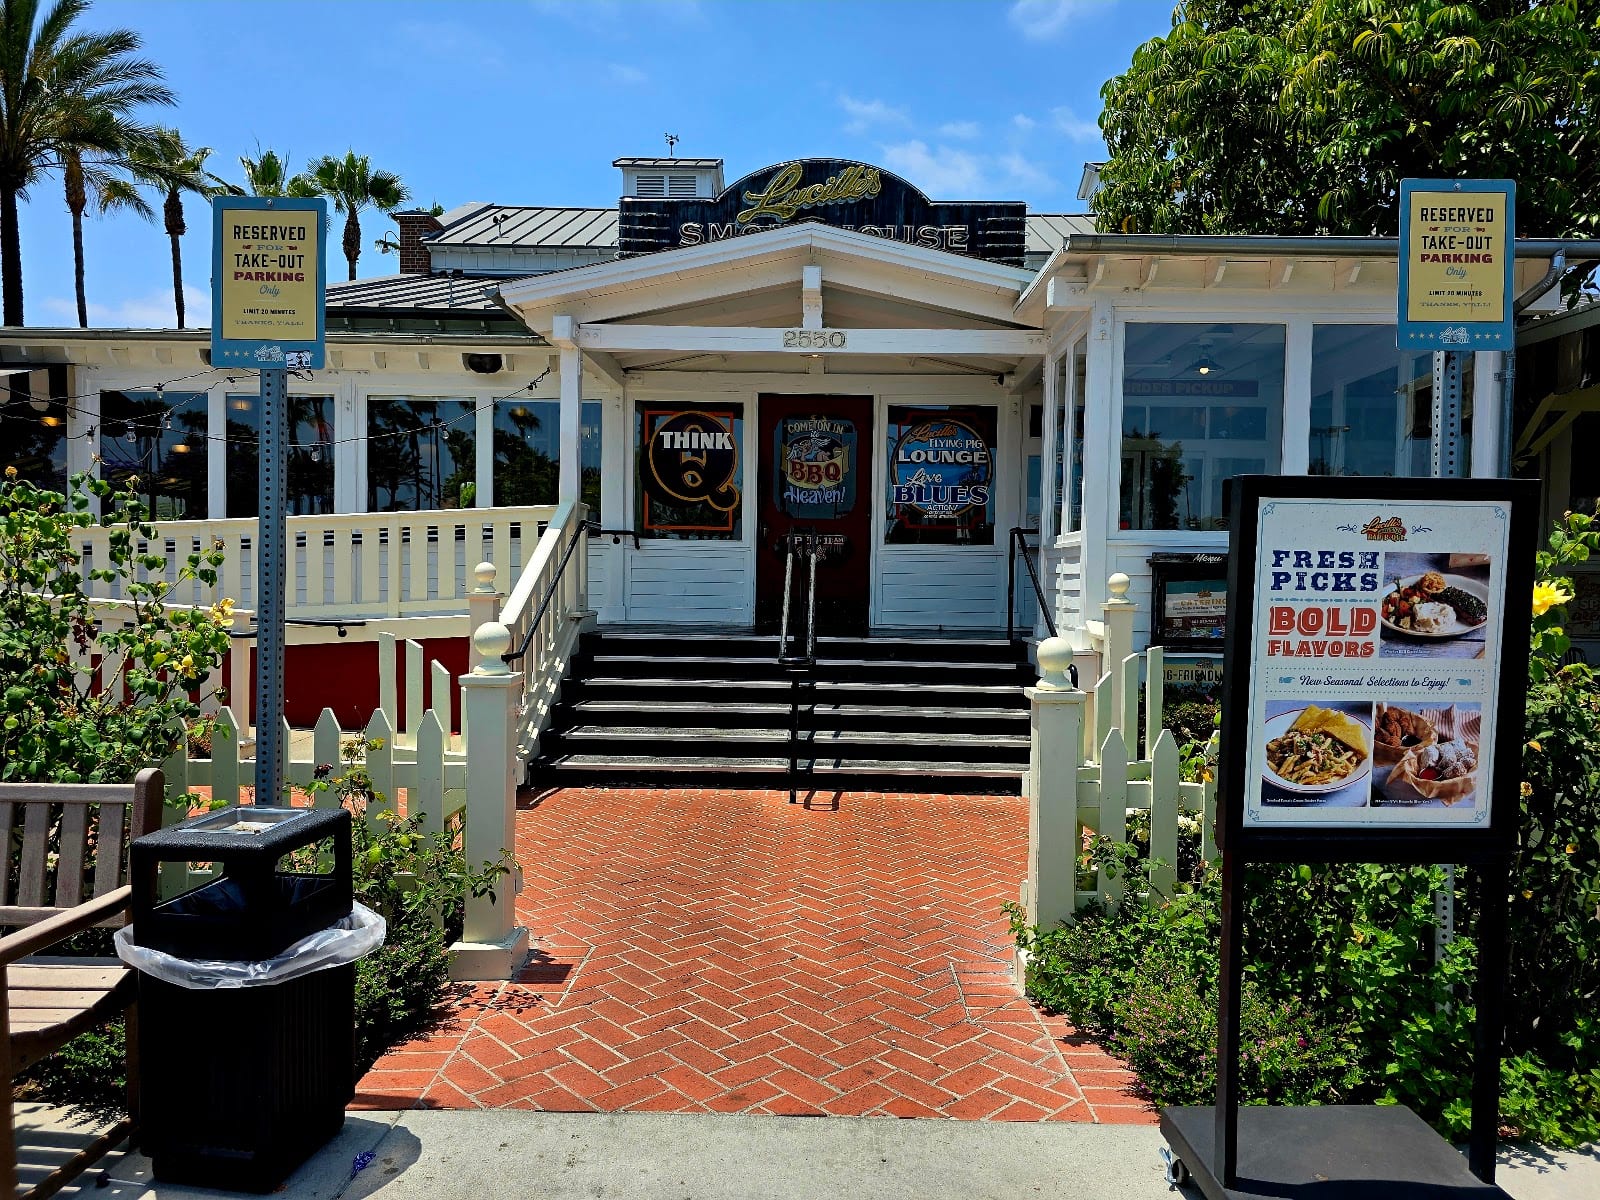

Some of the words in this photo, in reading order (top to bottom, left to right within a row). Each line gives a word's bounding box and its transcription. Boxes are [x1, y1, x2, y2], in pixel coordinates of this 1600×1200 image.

[736, 163, 881, 223] Lucille's
[1420, 207, 1494, 222] RESERVED
[233, 225, 306, 241] RESERVED
[1422, 235, 1493, 250] TAKE-OUT
[234, 253, 305, 268] TAKE-OUT
[1420, 253, 1493, 264] PARKING
[233, 271, 305, 282] PARKING
[1446, 266, 1468, 279] Only
[259, 284, 281, 297] Only
[784, 330, 846, 348] 2550
[1175, 382, 1234, 394] PICKUP
[659, 431, 734, 450] THINK
[907, 424, 958, 443] Lucille's
[929, 438, 963, 448] FLYING
[965, 439, 983, 449] PIG
[897, 449, 988, 463] LOUNGE
[904, 467, 943, 488] Live
[783, 484, 846, 504] Heaven!
[892, 484, 990, 506] BLUES
[1271, 550, 1380, 570] FRESH
[1270, 571, 1379, 592] PICKS
[1268, 606, 1377, 637] BOLD
[1267, 639, 1375, 658] FLAVORS
[1300, 675, 1323, 686] New
[1323, 675, 1364, 687] Seasonal
[1366, 676, 1409, 687] Selections
[1410, 677, 1420, 687] to
[1421, 676, 1451, 691] Enjoy!
